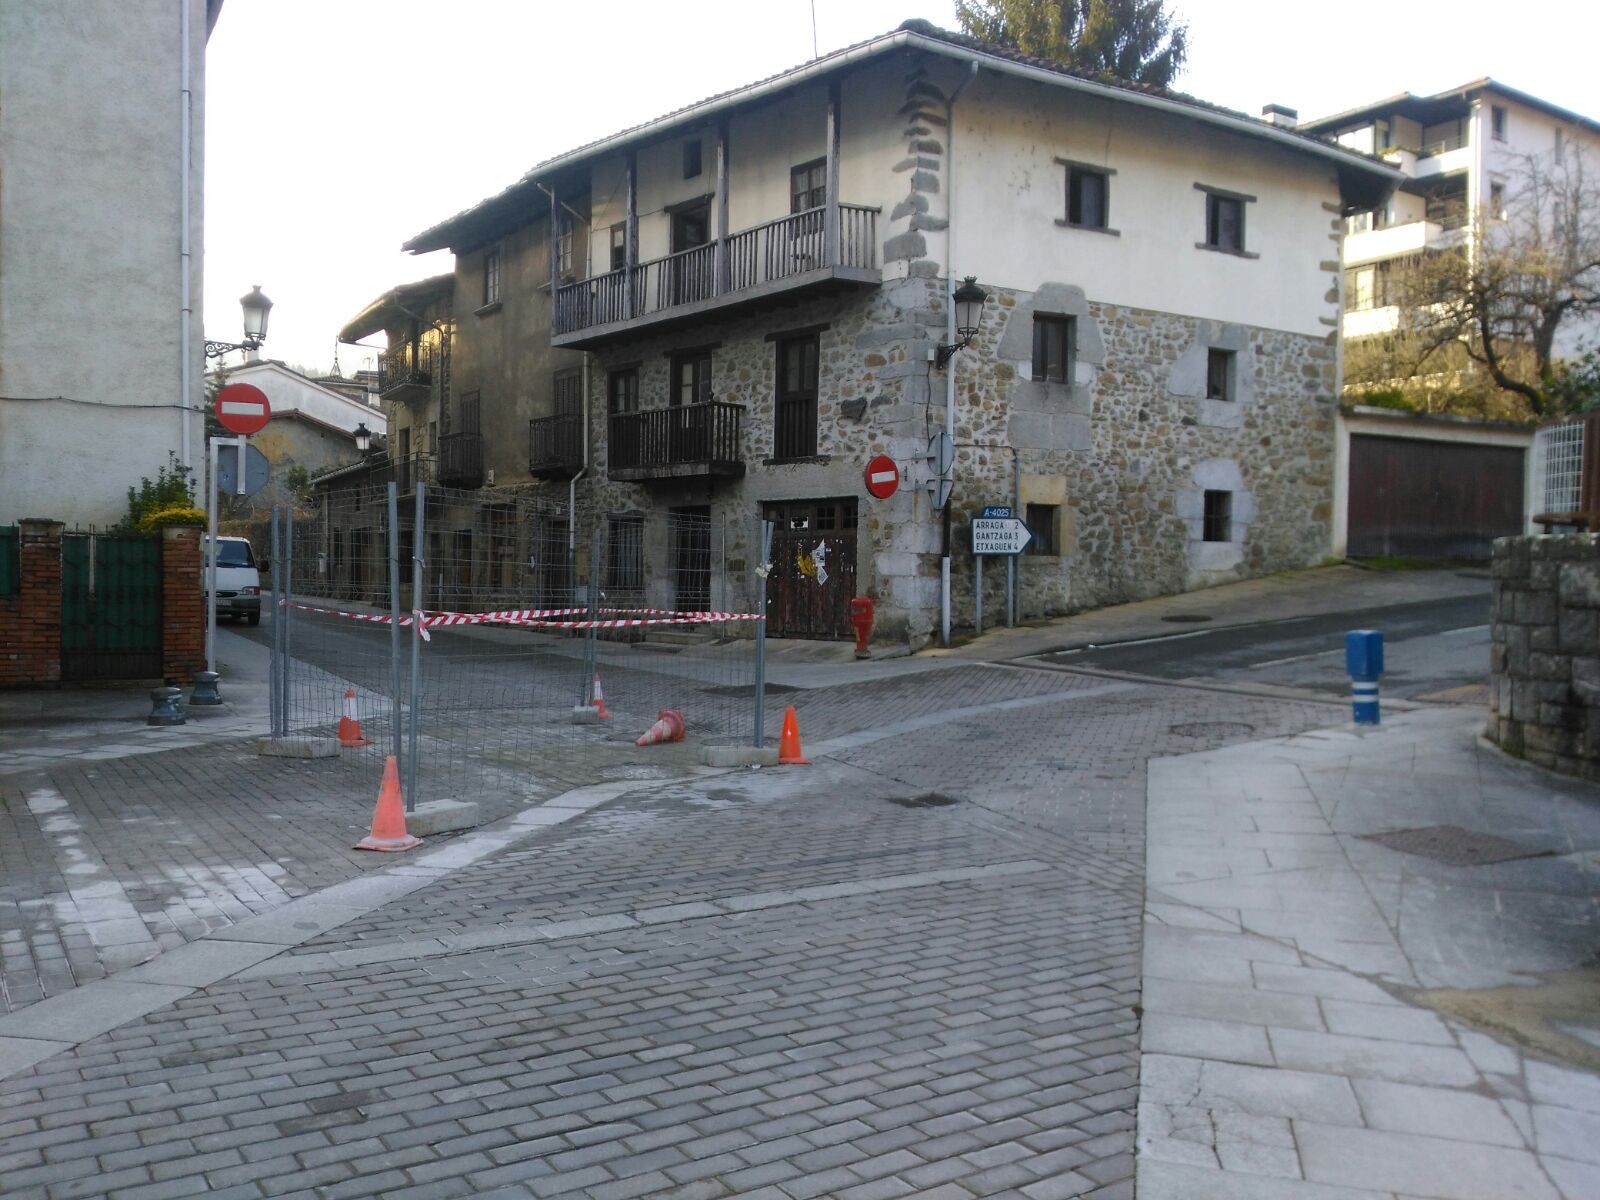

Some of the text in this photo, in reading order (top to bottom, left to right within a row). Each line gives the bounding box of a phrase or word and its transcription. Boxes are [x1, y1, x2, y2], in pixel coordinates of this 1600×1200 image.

[984, 508, 1009, 517] A-4025
[976, 521, 1004, 529] ARRAGA
[976, 532, 1013, 540] GANTZAGA
